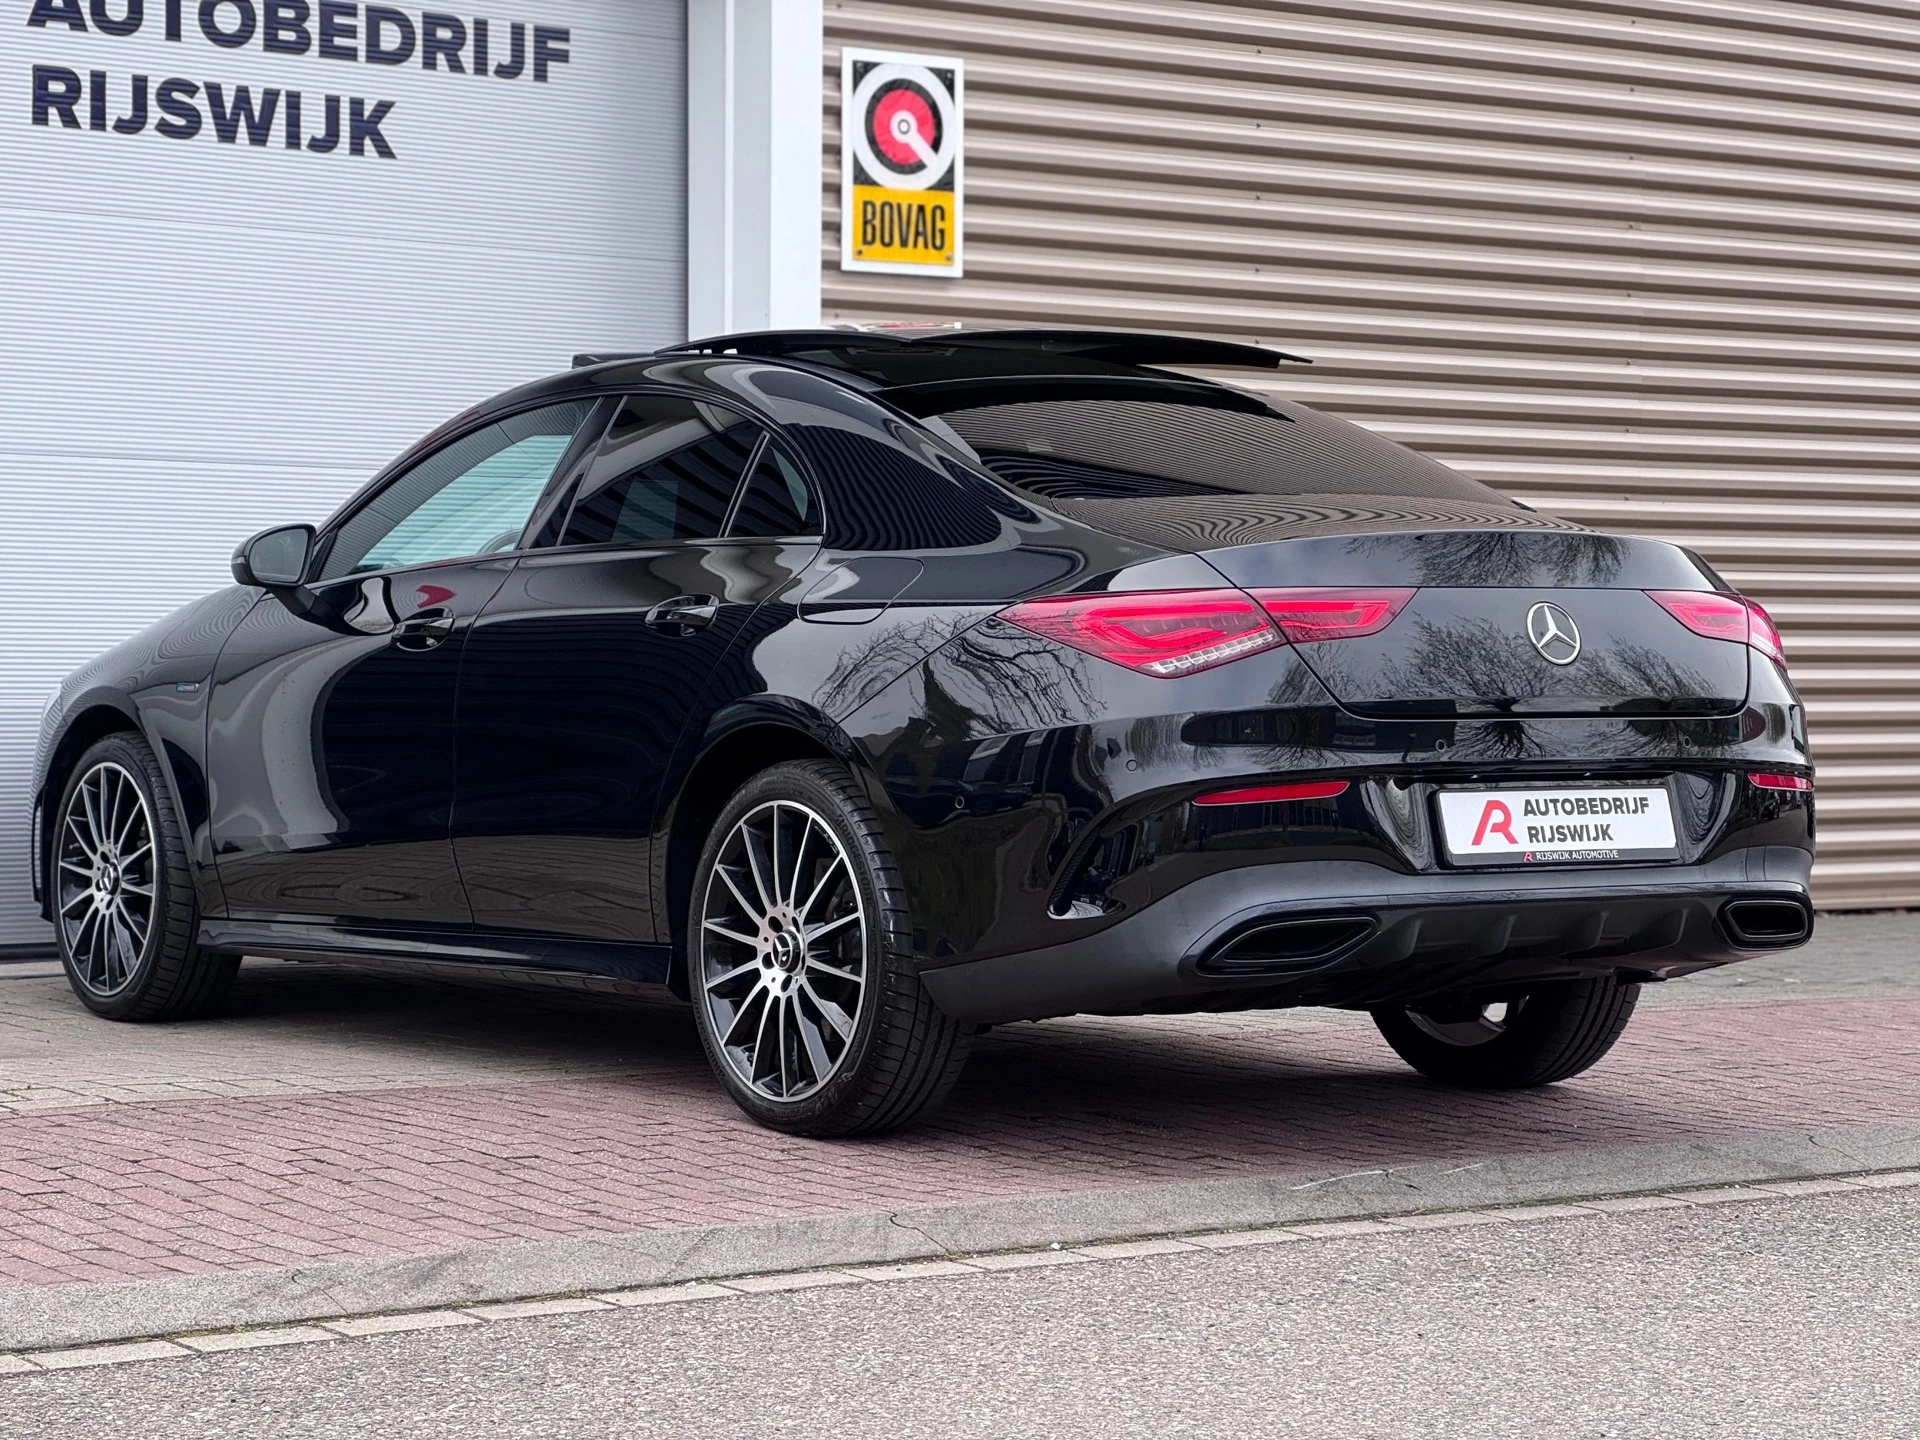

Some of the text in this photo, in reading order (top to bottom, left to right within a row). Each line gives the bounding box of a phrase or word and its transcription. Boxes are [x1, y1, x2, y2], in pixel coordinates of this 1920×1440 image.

[31, 64, 398, 160] RIJSWIJK
[862, 200, 945, 251] BOVAG
[1523, 797, 1650, 817] AUTOBEDRIJF
[1526, 823, 1614, 844] RIJSWIJK
[1535, 851, 1571, 861] RIJSWIJK
[1572, 849, 1619, 860] AUTOMOTIVE
